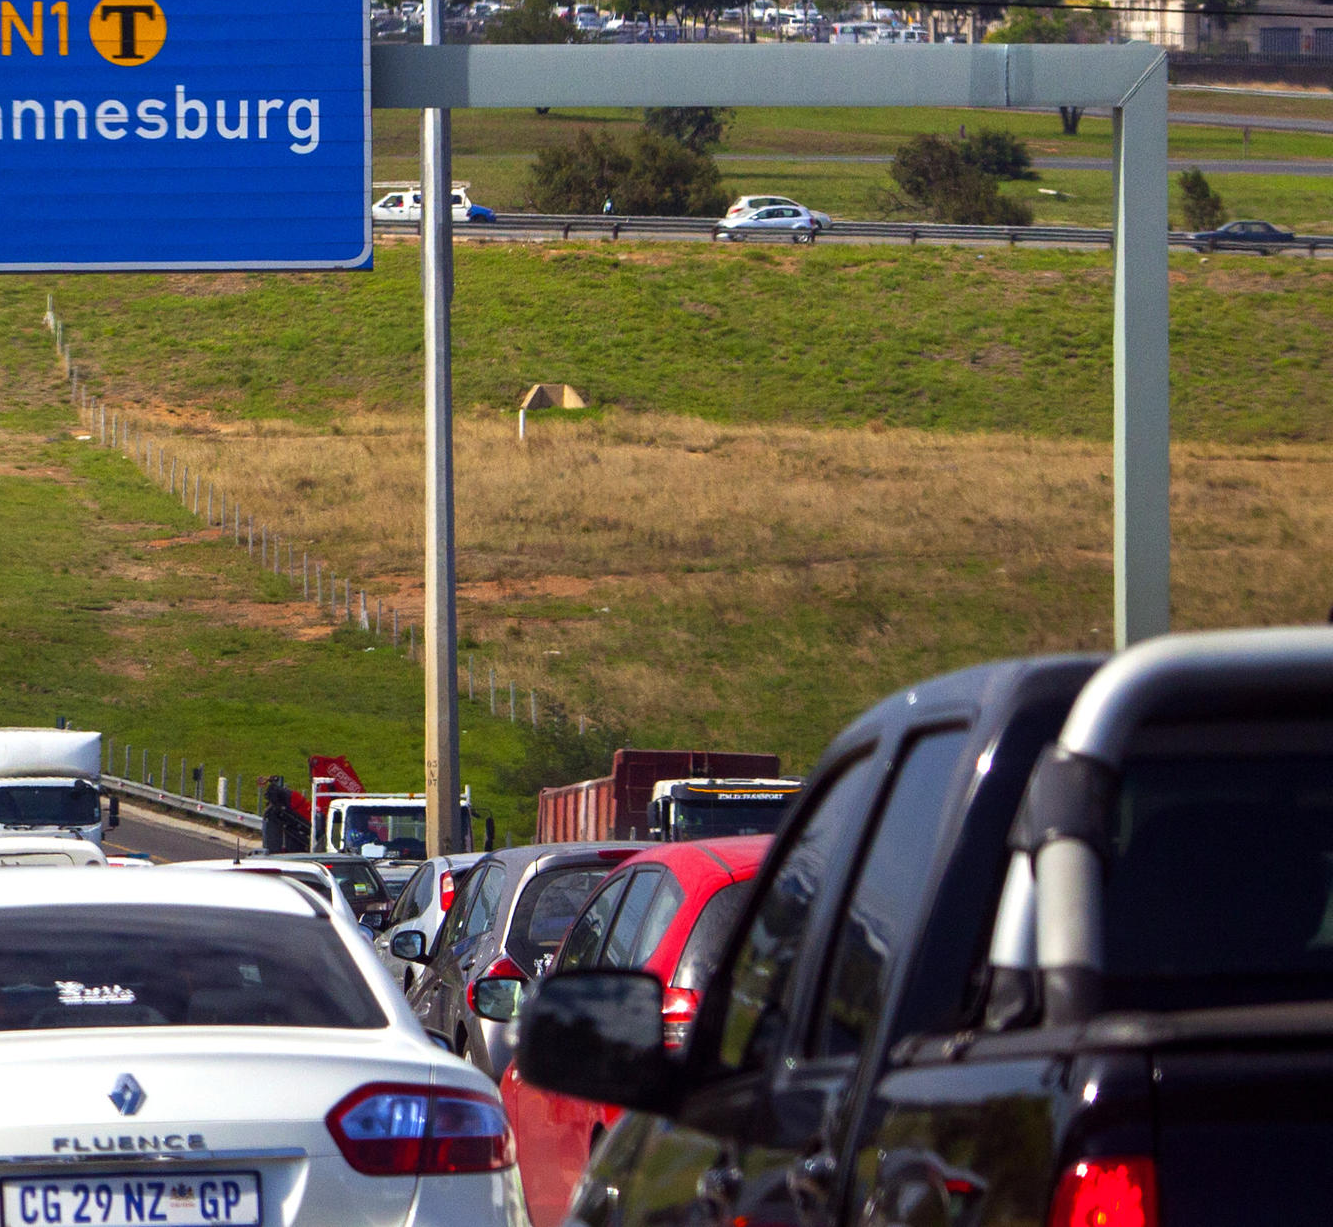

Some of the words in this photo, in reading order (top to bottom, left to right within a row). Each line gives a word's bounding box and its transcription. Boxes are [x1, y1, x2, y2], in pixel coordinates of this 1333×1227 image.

[1, 1, 68, 55] N1
[52, 1134, 207, 1153] FLUENCE
[20, 1185, 62, 1224] CG
[72, 1184, 113, 1223] 29
[124, 1182, 167, 1222] NZ
[199, 1181, 241, 1221] GP
